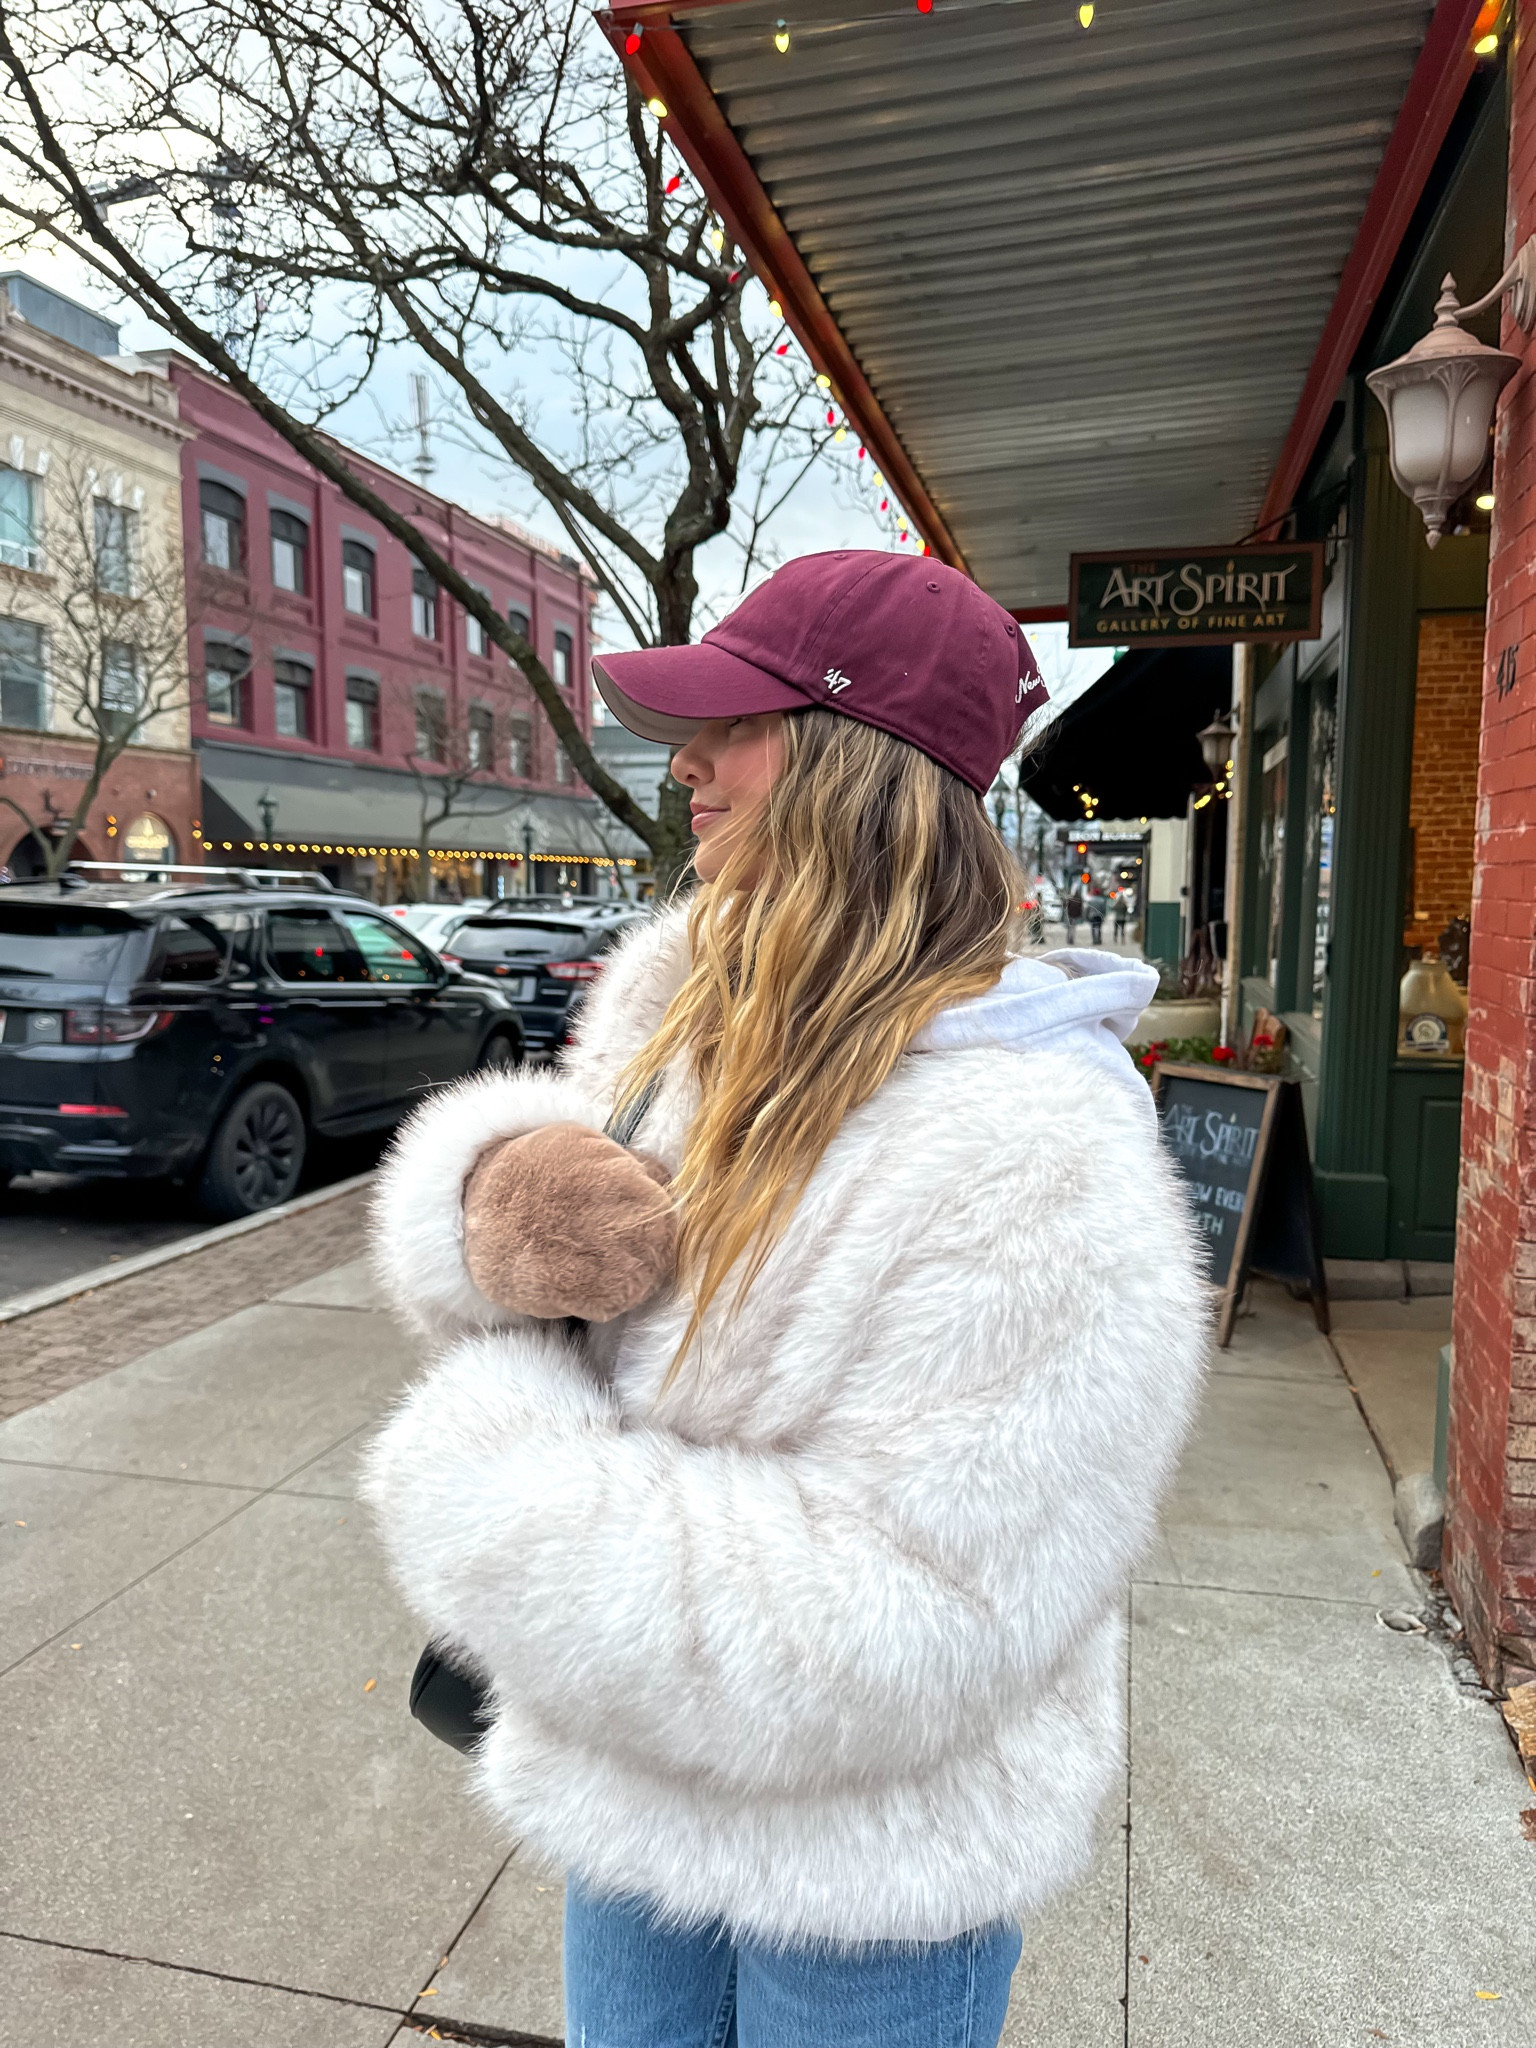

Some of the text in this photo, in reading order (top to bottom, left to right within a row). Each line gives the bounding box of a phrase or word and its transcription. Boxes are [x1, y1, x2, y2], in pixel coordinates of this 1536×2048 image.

[1099, 566, 1175, 617] ART
[1096, 612, 1286, 633] GALLERY OF FINE ART
